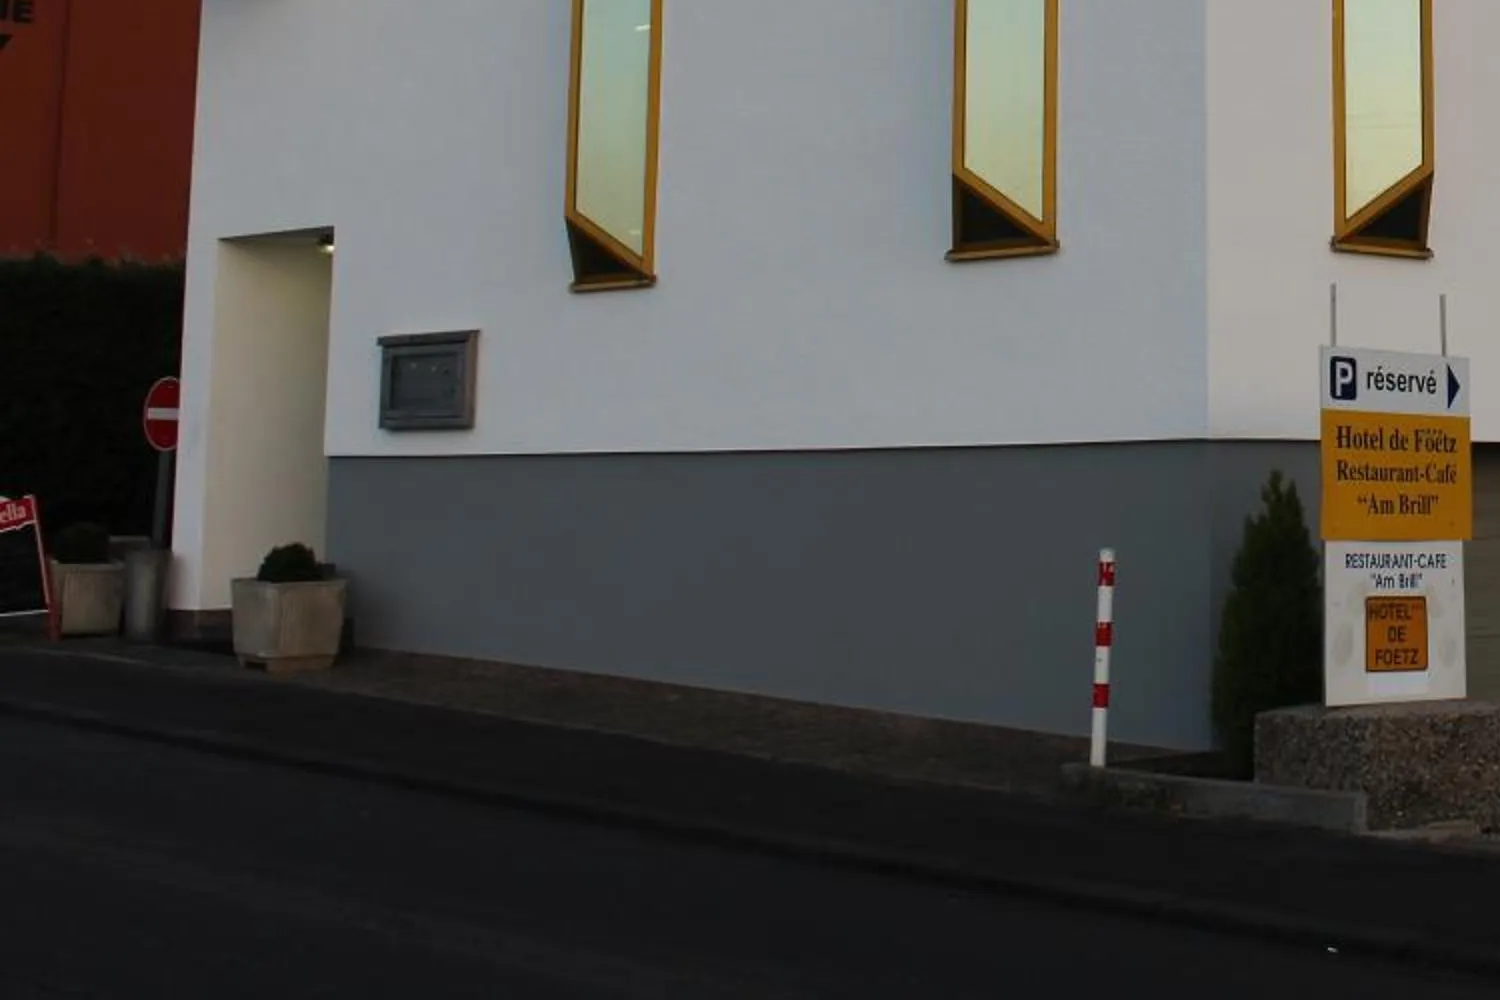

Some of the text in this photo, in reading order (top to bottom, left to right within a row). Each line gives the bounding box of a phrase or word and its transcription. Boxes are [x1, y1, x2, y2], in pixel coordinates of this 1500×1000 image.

[1367, 366, 1437, 395] réservé
[1336, 425, 1383, 450] Hotel
[1389, 428, 1409, 451] de
[1336, 460, 1457, 485] Restaurant-Café
[1369, 603, 1412, 620] HOTEL
[1387, 626, 1407, 643] DE
[1375, 649, 1419, 665] FOETZ
